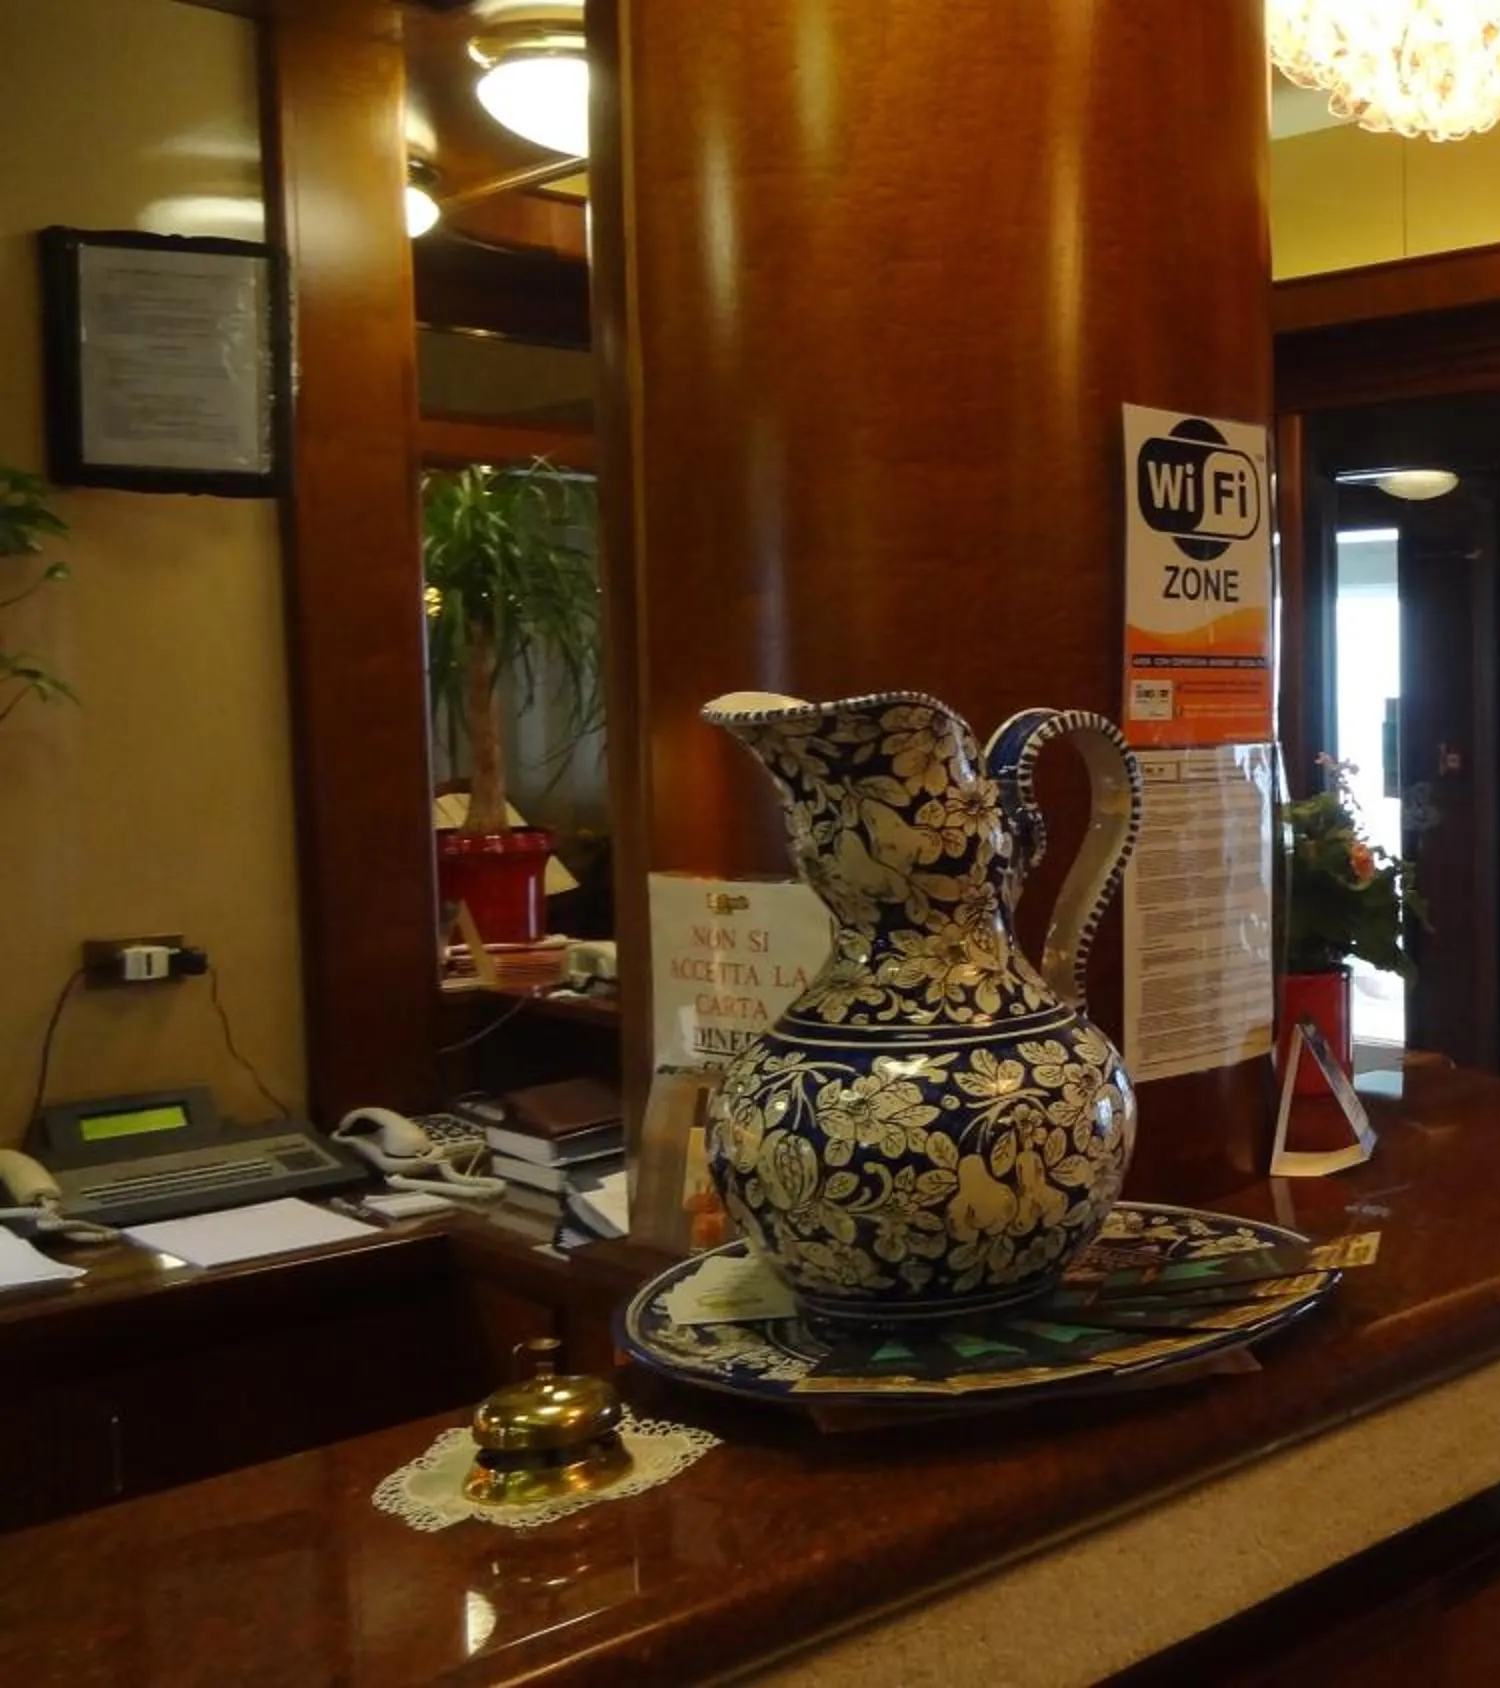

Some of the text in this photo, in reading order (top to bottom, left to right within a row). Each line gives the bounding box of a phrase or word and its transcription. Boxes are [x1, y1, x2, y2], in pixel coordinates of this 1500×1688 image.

[1162, 565, 1240, 603] ZONE
[690, 925, 769, 953] NON SI
[669, 957, 809, 995] ACCETTA LA
[695, 993, 768, 1021] CARTA
